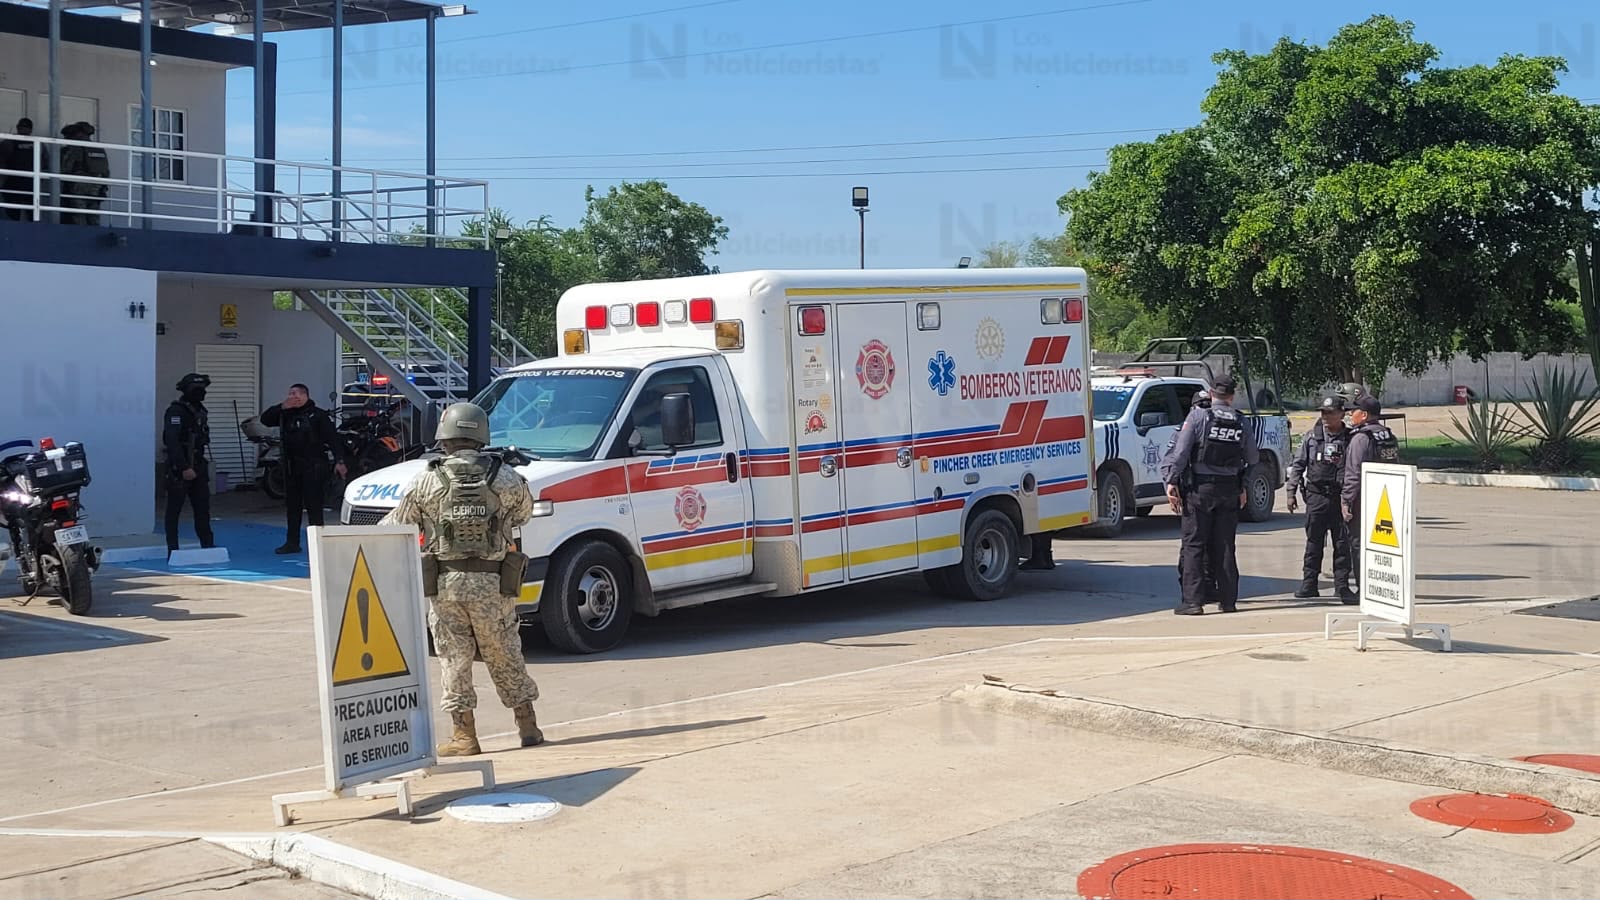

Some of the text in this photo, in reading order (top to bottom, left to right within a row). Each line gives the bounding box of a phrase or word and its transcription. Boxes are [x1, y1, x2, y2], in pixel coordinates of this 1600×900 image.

[545, 368, 625, 378] VETERANOS
[960, 367, 1082, 400] BOMBEROS VETERANOS
[798, 399, 818, 407] Rotary
[1209, 427, 1242, 440] SSPC
[933, 441, 1081, 473] PINCHER CREEK EMERGENCY SERVICES
[342, 719, 408, 744] ÁREA FUERA
[344, 741, 409, 768] DE SERVICIO
